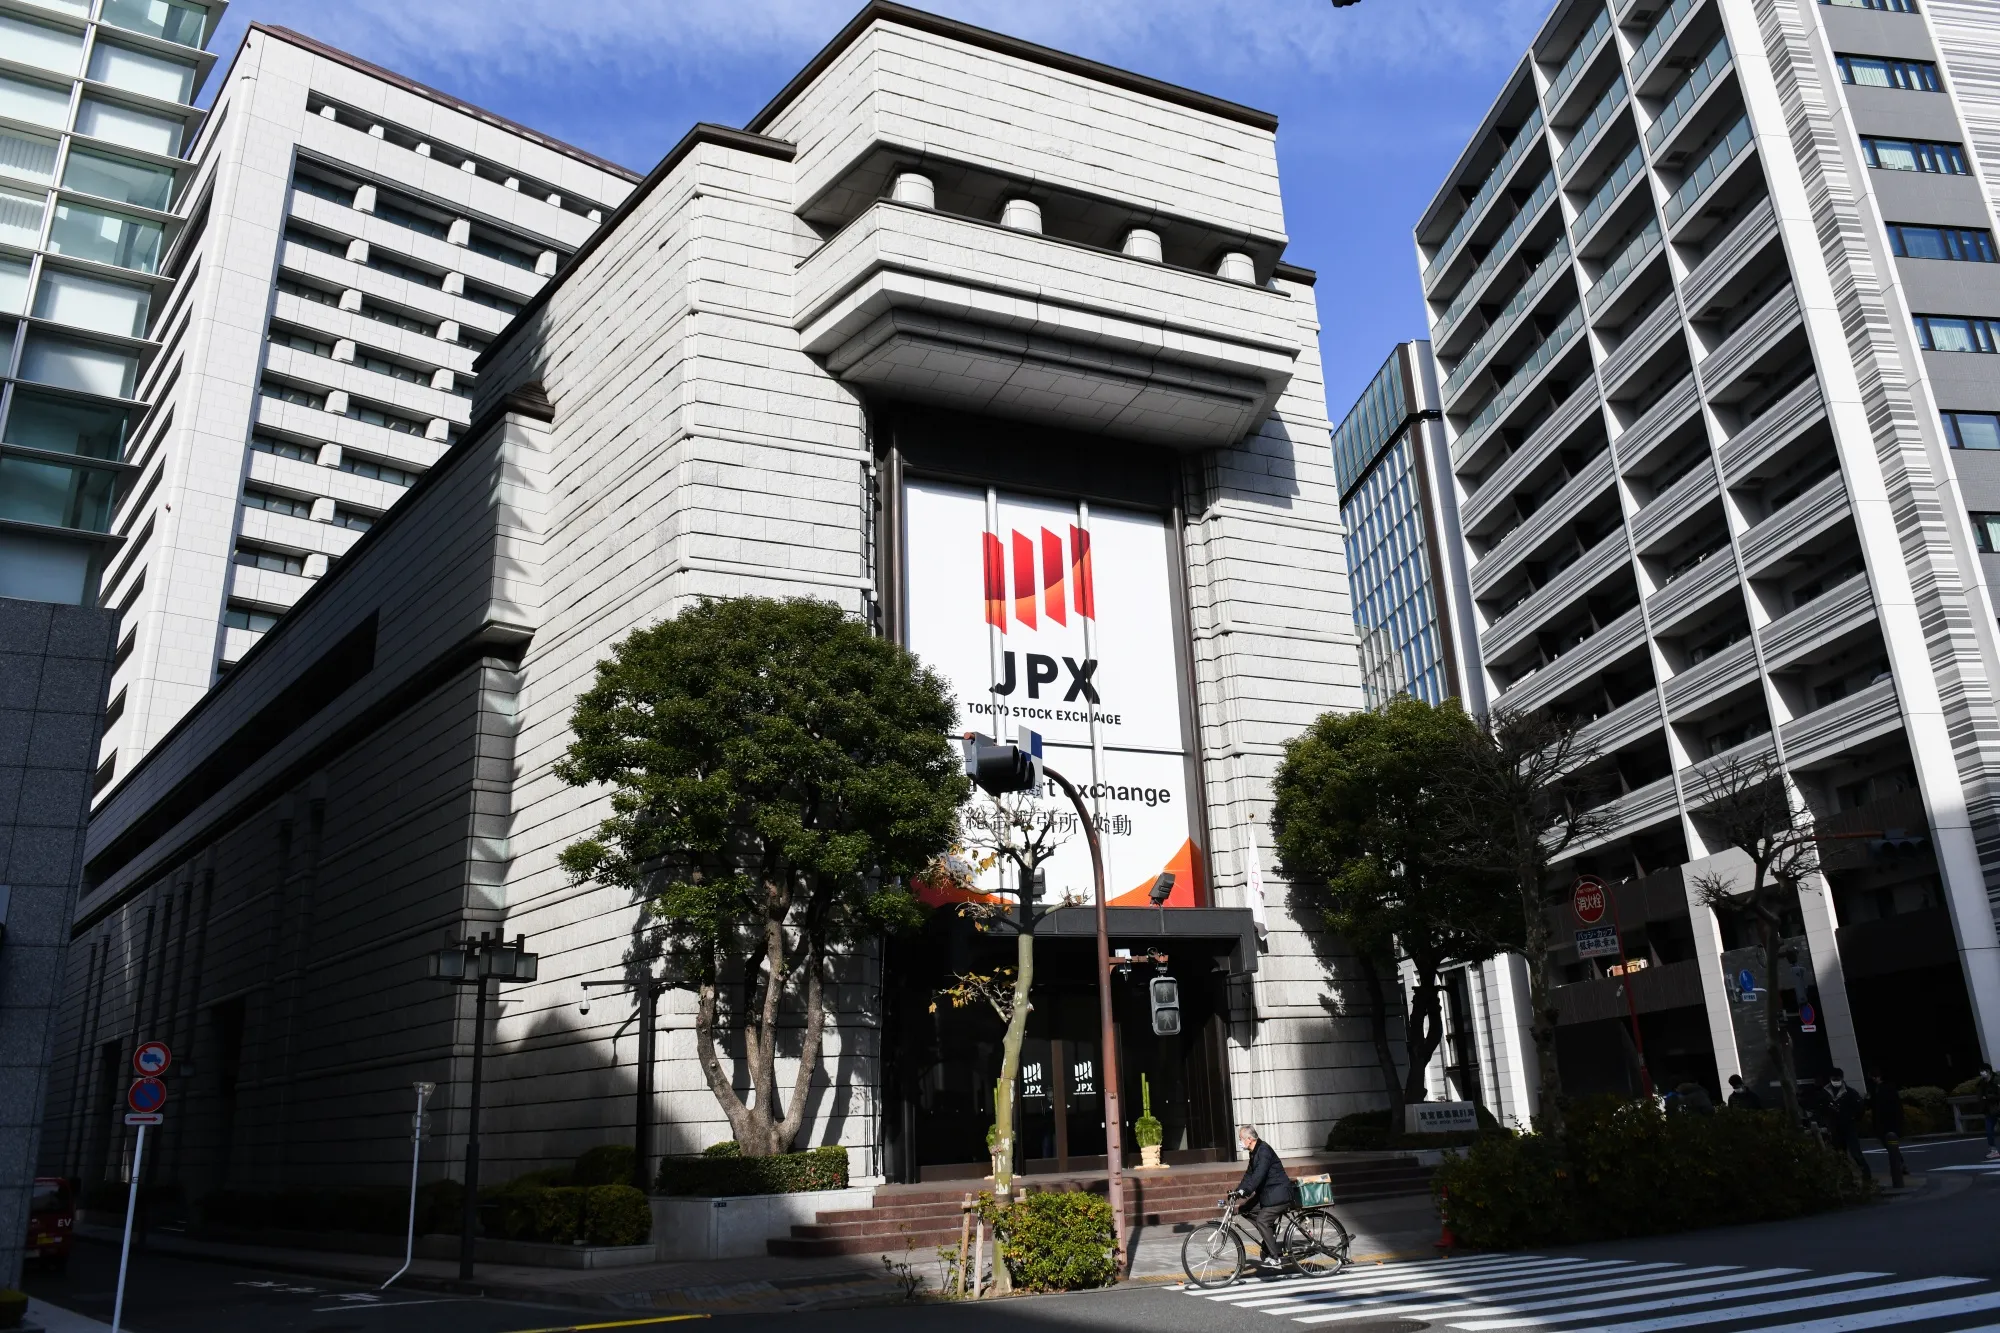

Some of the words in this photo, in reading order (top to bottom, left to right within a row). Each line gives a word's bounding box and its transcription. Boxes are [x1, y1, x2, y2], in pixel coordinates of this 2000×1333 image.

[989, 651, 1100, 704] JPX
[1013, 707, 1052, 720] STOCK
[1577, 893, 1602, 911] 消火栓
[1024, 1085, 1042, 1094] JPX
[1076, 1083, 1093, 1092] JPX
[57, 1218, 72, 1228] EV
